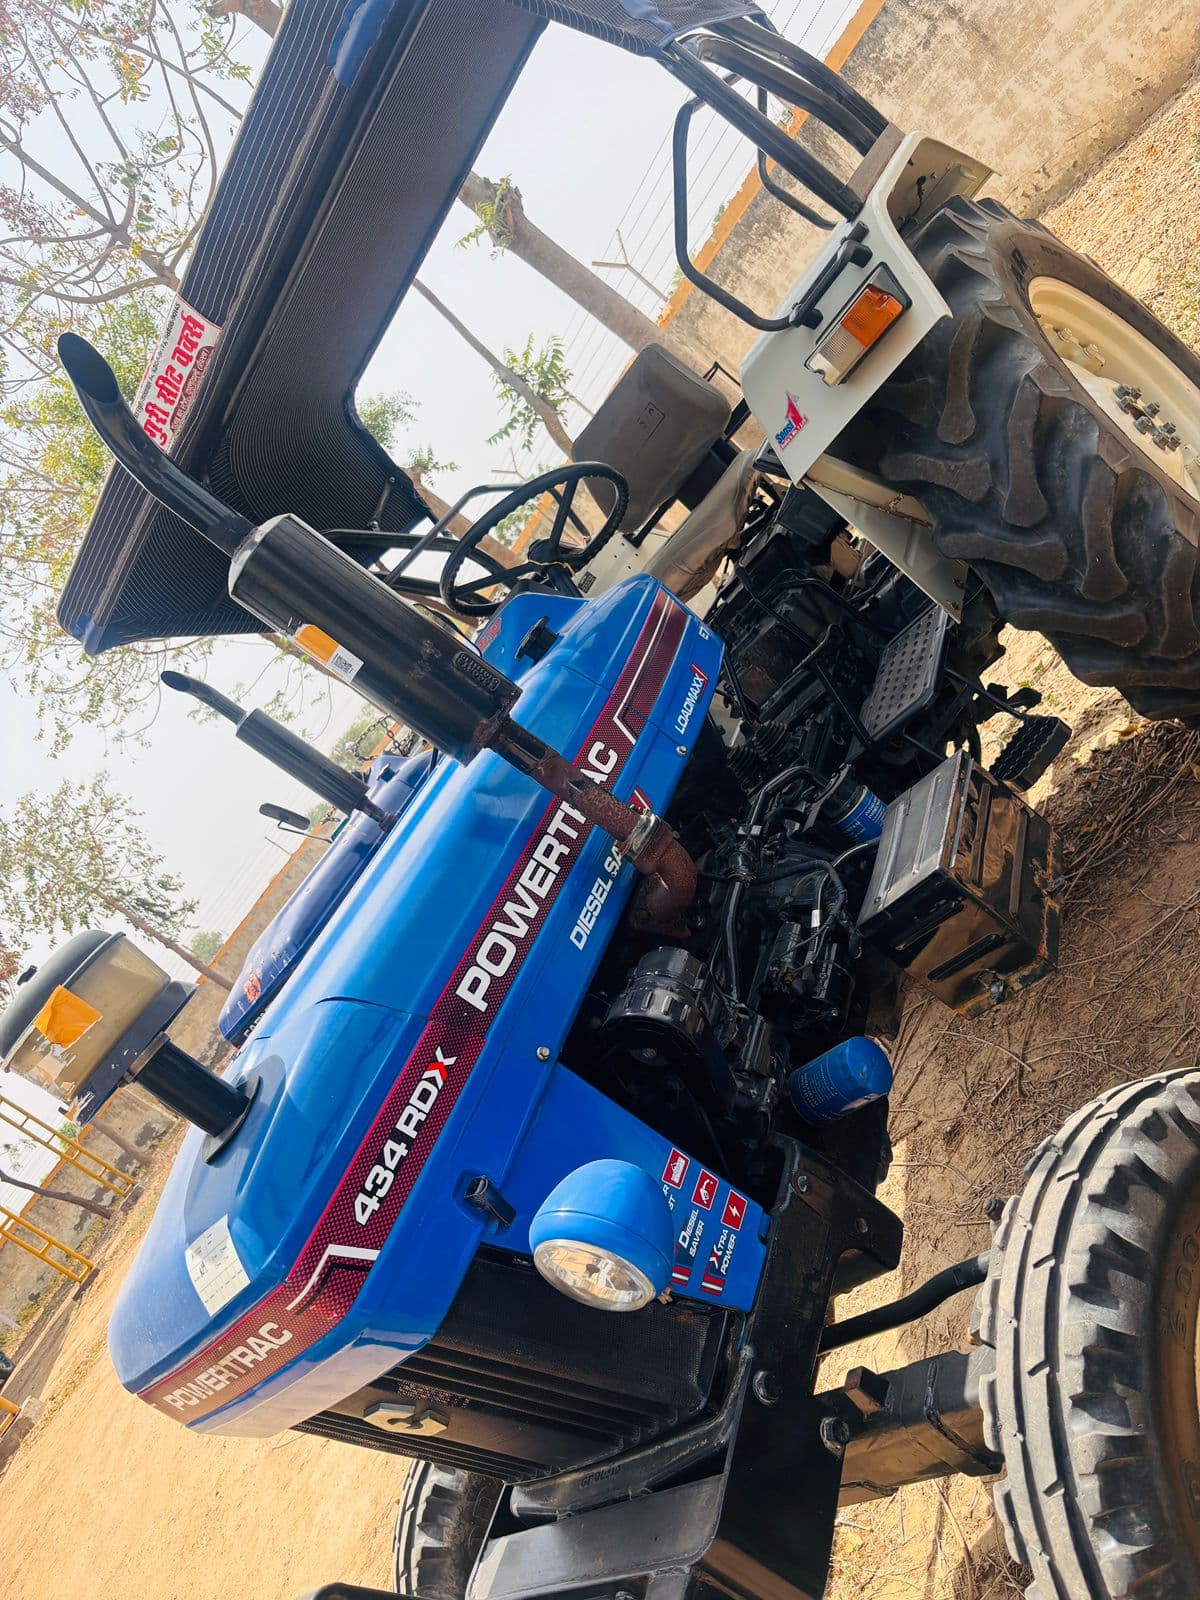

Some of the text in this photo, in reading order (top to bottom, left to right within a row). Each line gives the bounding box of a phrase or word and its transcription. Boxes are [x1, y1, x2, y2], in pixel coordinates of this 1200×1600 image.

[155, 364, 184, 406] सीट
[143, 401, 170, 446] गुरी
[674, 673, 704, 734] LOADMAXX
[569, 877, 613, 951] DIESEL
[354, 1046, 457, 1226] 434 RDX
[689, 1220, 705, 1257] SAVER
[720, 1234, 737, 1275] POWER
[163, 1322, 293, 1411] POWERTRAC
